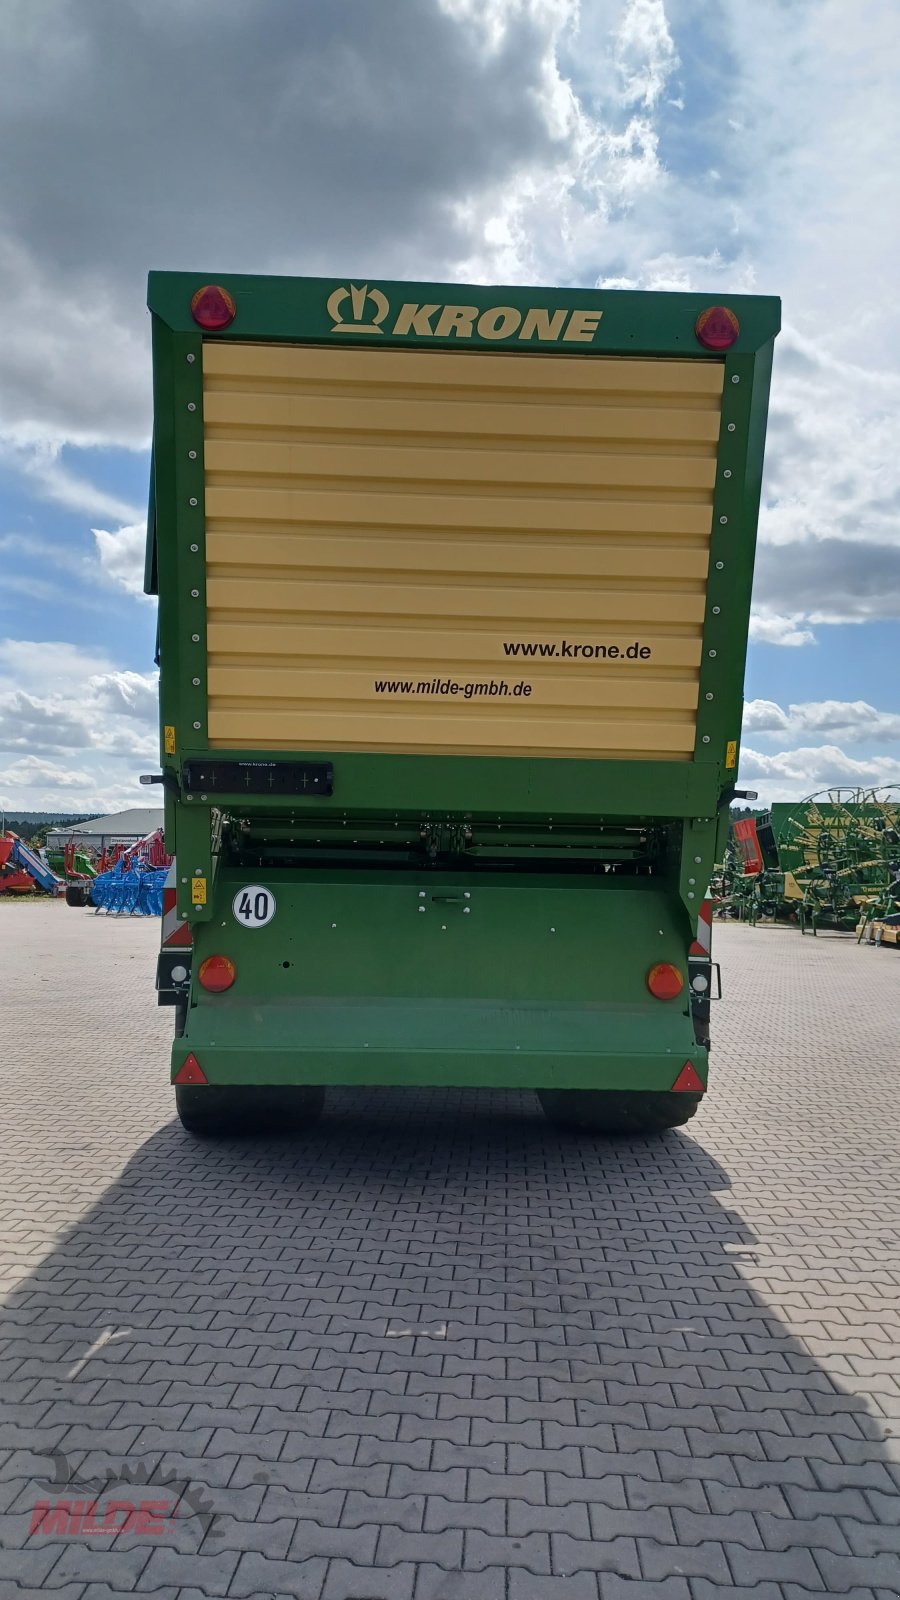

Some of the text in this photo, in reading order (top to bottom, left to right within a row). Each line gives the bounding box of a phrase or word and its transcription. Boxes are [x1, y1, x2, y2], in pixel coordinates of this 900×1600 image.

[391, 303, 603, 342] KRONE
[503, 640, 651, 659] www.krone.de
[374, 679, 532, 698] www.milde-gmbh.de
[238, 892, 268, 920] 40
